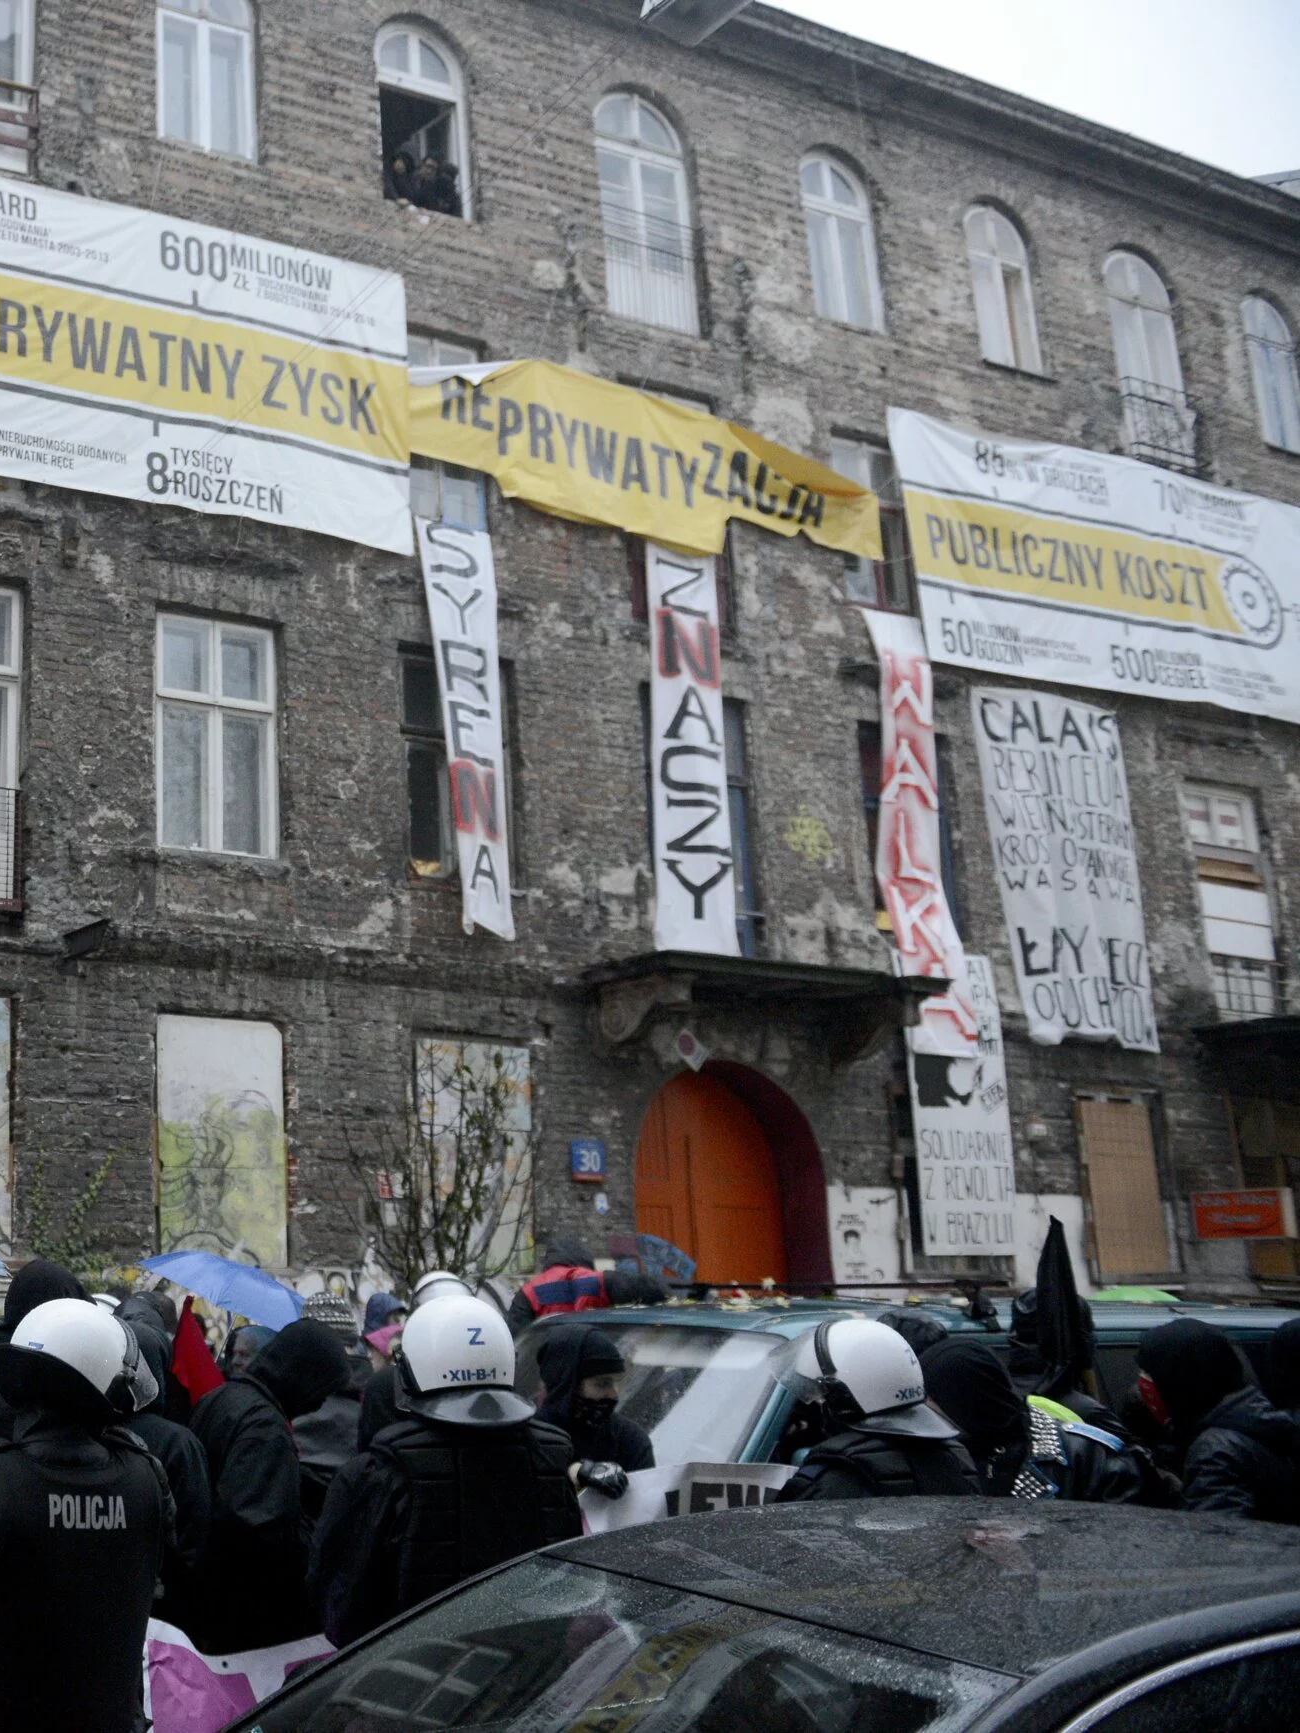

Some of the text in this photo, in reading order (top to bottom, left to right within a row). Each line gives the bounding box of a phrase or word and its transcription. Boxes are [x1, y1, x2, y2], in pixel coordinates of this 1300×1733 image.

[160, 230, 332, 291] 600 MILIONÓW
[233, 272, 251, 292] ZŁ
[261, 354, 377, 435] ZYSK
[51, 455, 75, 471] RĘCE
[146, 447, 234, 495] 8 TYSIĘCY
[173, 469, 283, 515] ROSZCZEŃ
[926, 512, 1208, 610] PUBLICZNY KOSZT
[941, 617, 973, 657] 50
[975, 638, 1024, 666] GODZIN
[1110, 644, 1157, 684] 500
[427, 523, 499, 904] SYRENA
[655, 556, 733, 920] ZNACZY
[579, 1149, 601, 1172] 30
[923, 1166, 936, 1201] Z
[467, 1328, 486, 1346] Z
[449, 1367, 496, 1382] XII-B-1
[48, 1493, 127, 1531] POLICJA
